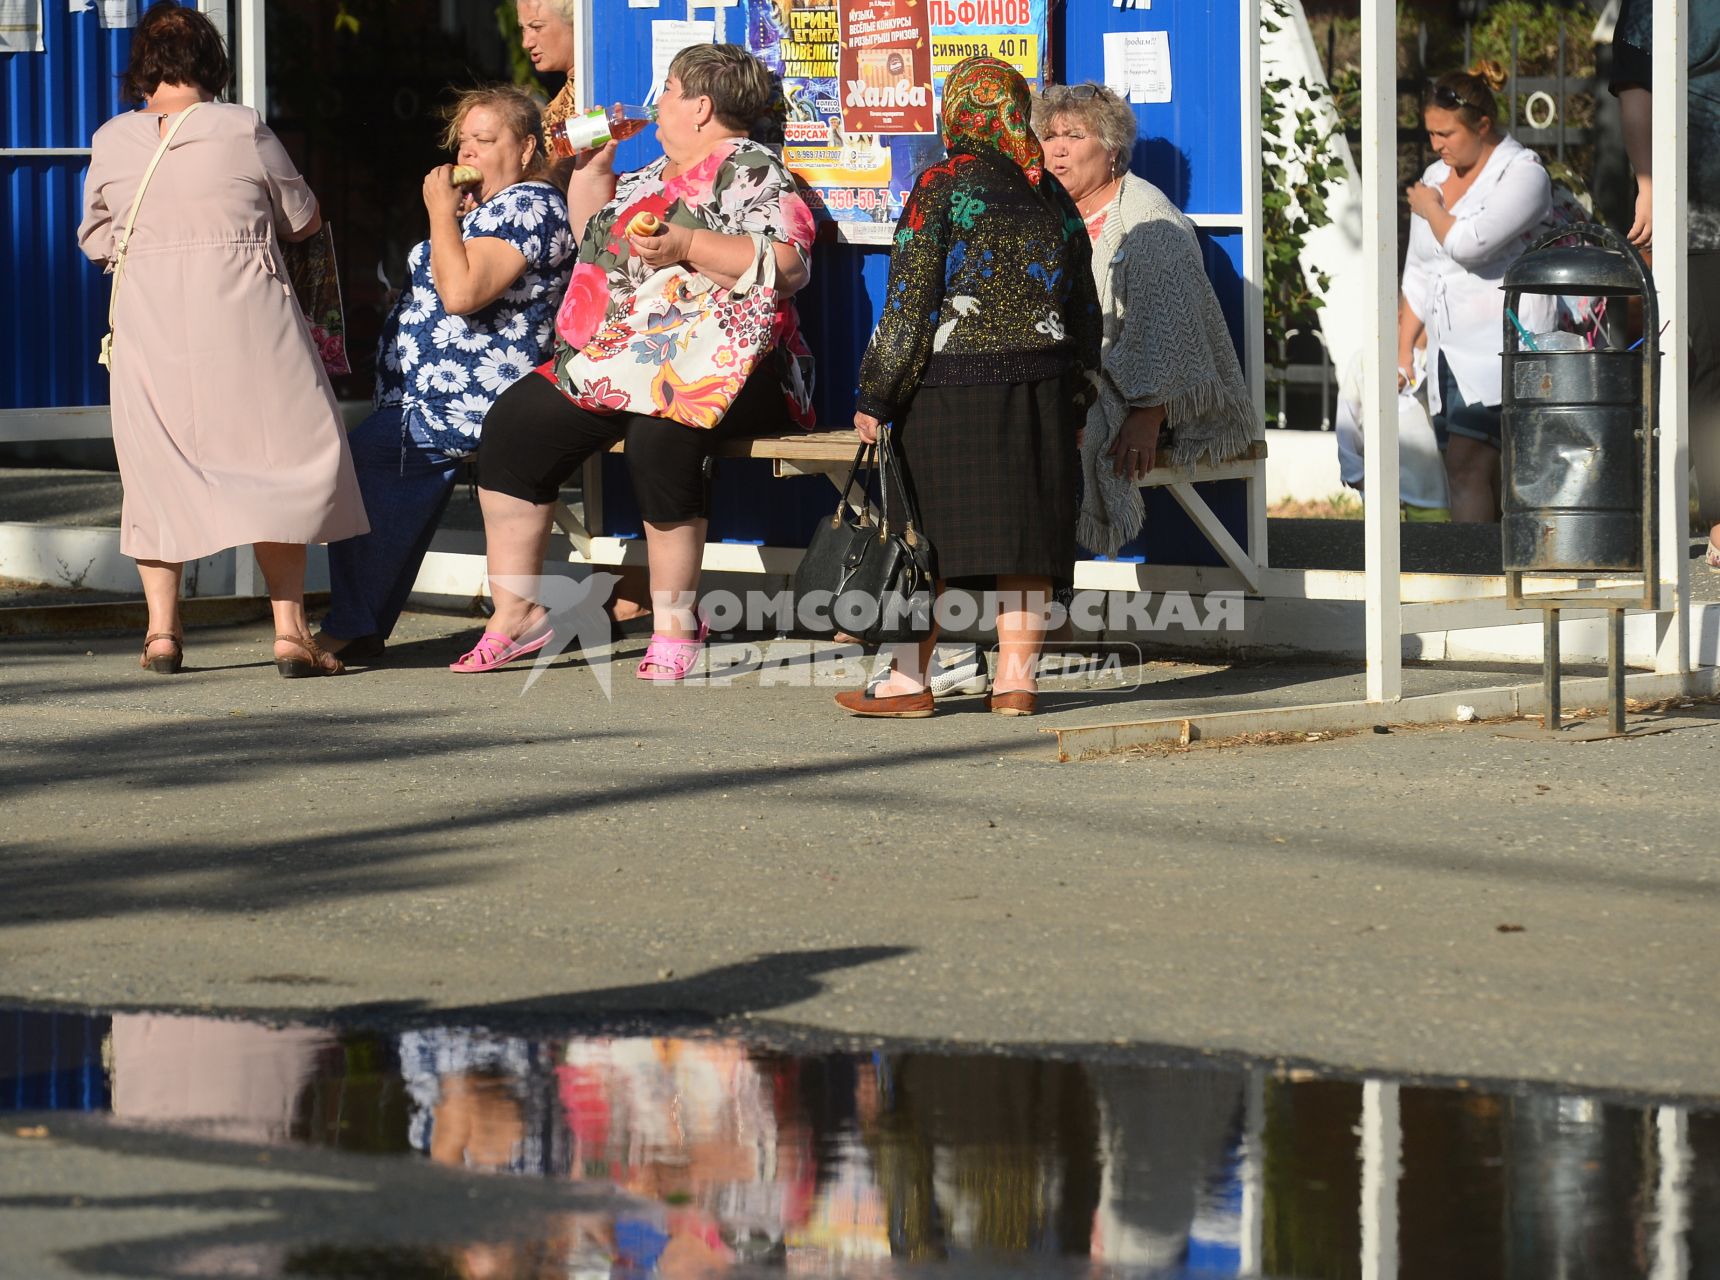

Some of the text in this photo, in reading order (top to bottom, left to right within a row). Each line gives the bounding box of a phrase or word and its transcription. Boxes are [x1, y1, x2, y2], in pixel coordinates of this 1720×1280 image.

[930, 0, 1030, 25] ЛЬФИНОВ
[849, 16, 912, 35] ВЕСЁЛЫЕ КОНКУРСЫ
[854, 32, 890, 47] РОЗЫГРЫШ
[891, 28, 919, 42] ПРИЗОВ!
[780, 38, 839, 61] ПОВЕЛИТЕ
[932, 43, 993, 58] сиянова,
[999, 40, 1015, 56] 40
[845, 79, 927, 107] Халва
[785, 130, 828, 139] ФОРСАЖ
